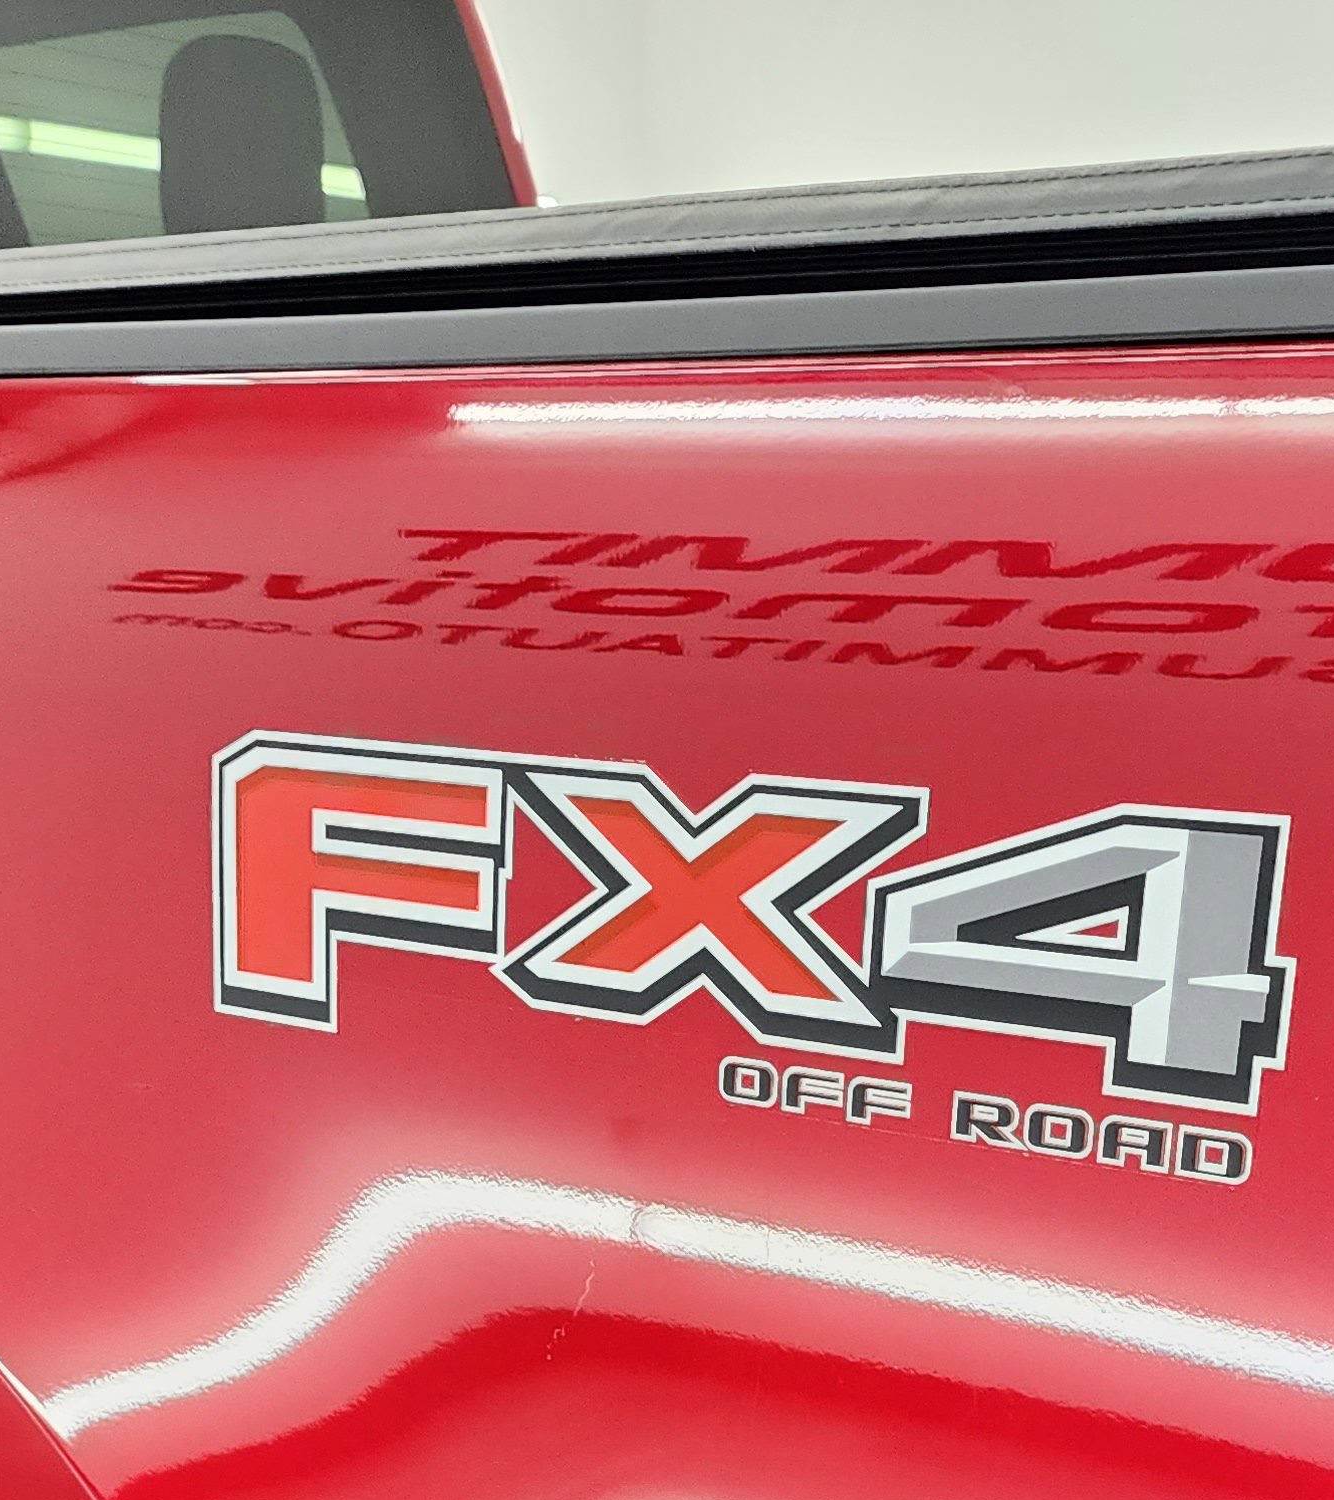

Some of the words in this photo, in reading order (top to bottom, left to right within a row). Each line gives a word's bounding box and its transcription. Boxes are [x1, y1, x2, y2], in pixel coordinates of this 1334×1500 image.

[212, 729, 1296, 1116] FX4
[717, 1054, 915, 1124] OFF
[949, 1088, 1253, 1186] ROAD
